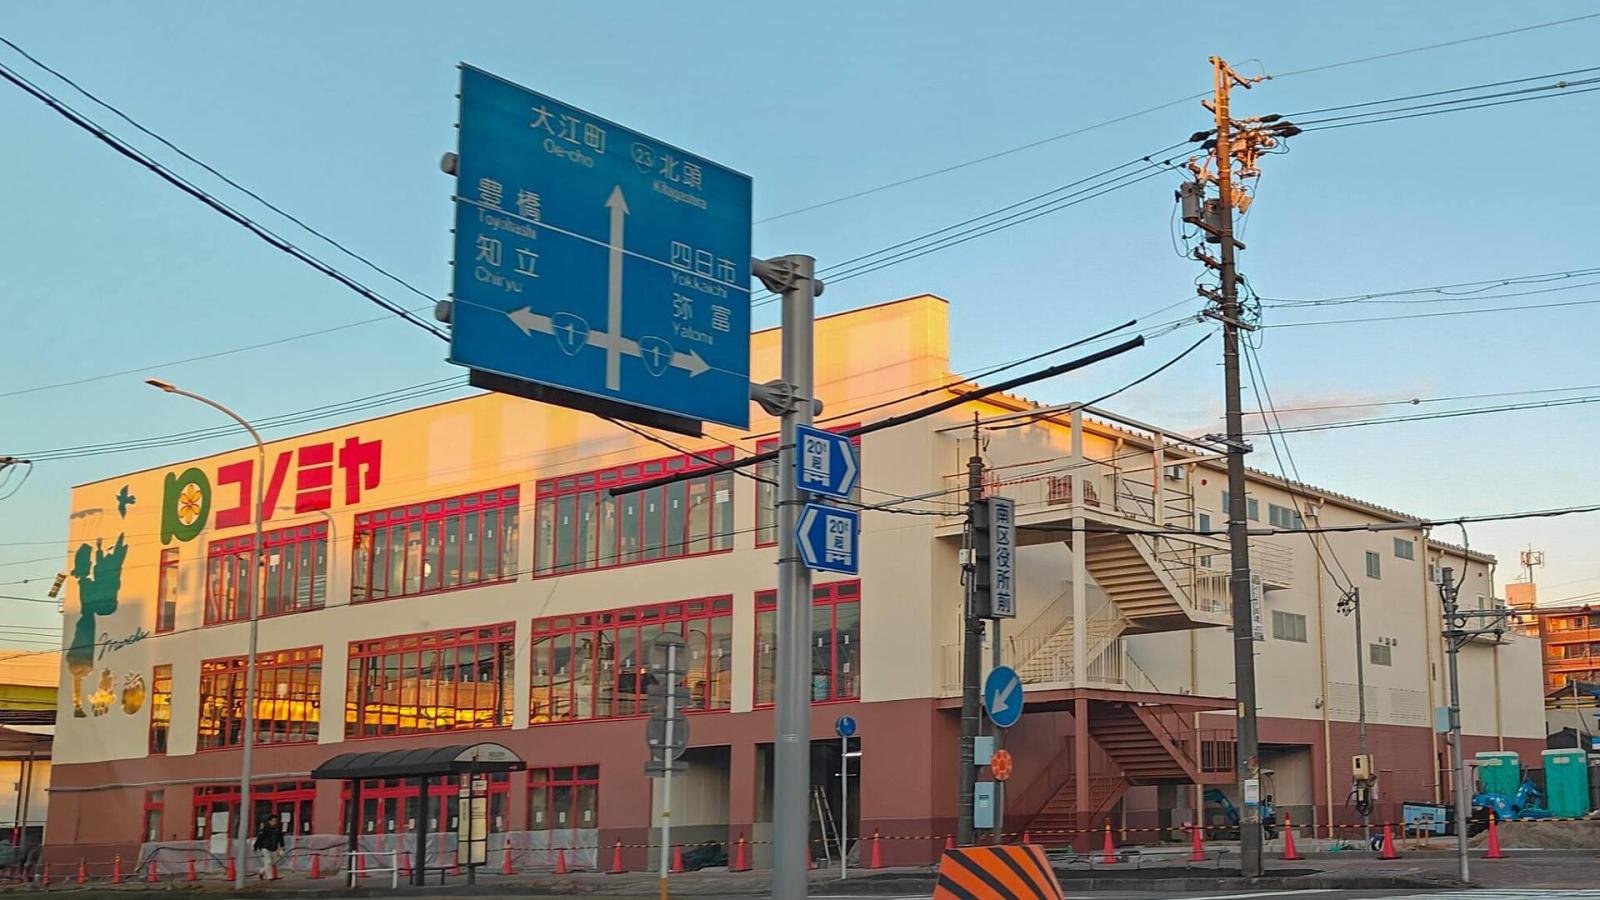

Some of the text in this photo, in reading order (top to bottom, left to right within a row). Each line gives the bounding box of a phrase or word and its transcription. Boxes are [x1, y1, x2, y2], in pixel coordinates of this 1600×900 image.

[529, 105, 606, 154] 大江町
[543, 138, 594, 168] Oe-cho
[659, 154, 703, 191] 北頭
[477, 177, 541, 221] 豊橋
[475, 233, 540, 277] 知立
[670, 240, 736, 284] 四日市
[565, 323, 575, 345] 1
[672, 293, 731, 332] 弥富
[215, 436, 382, 530] コノミヤ
